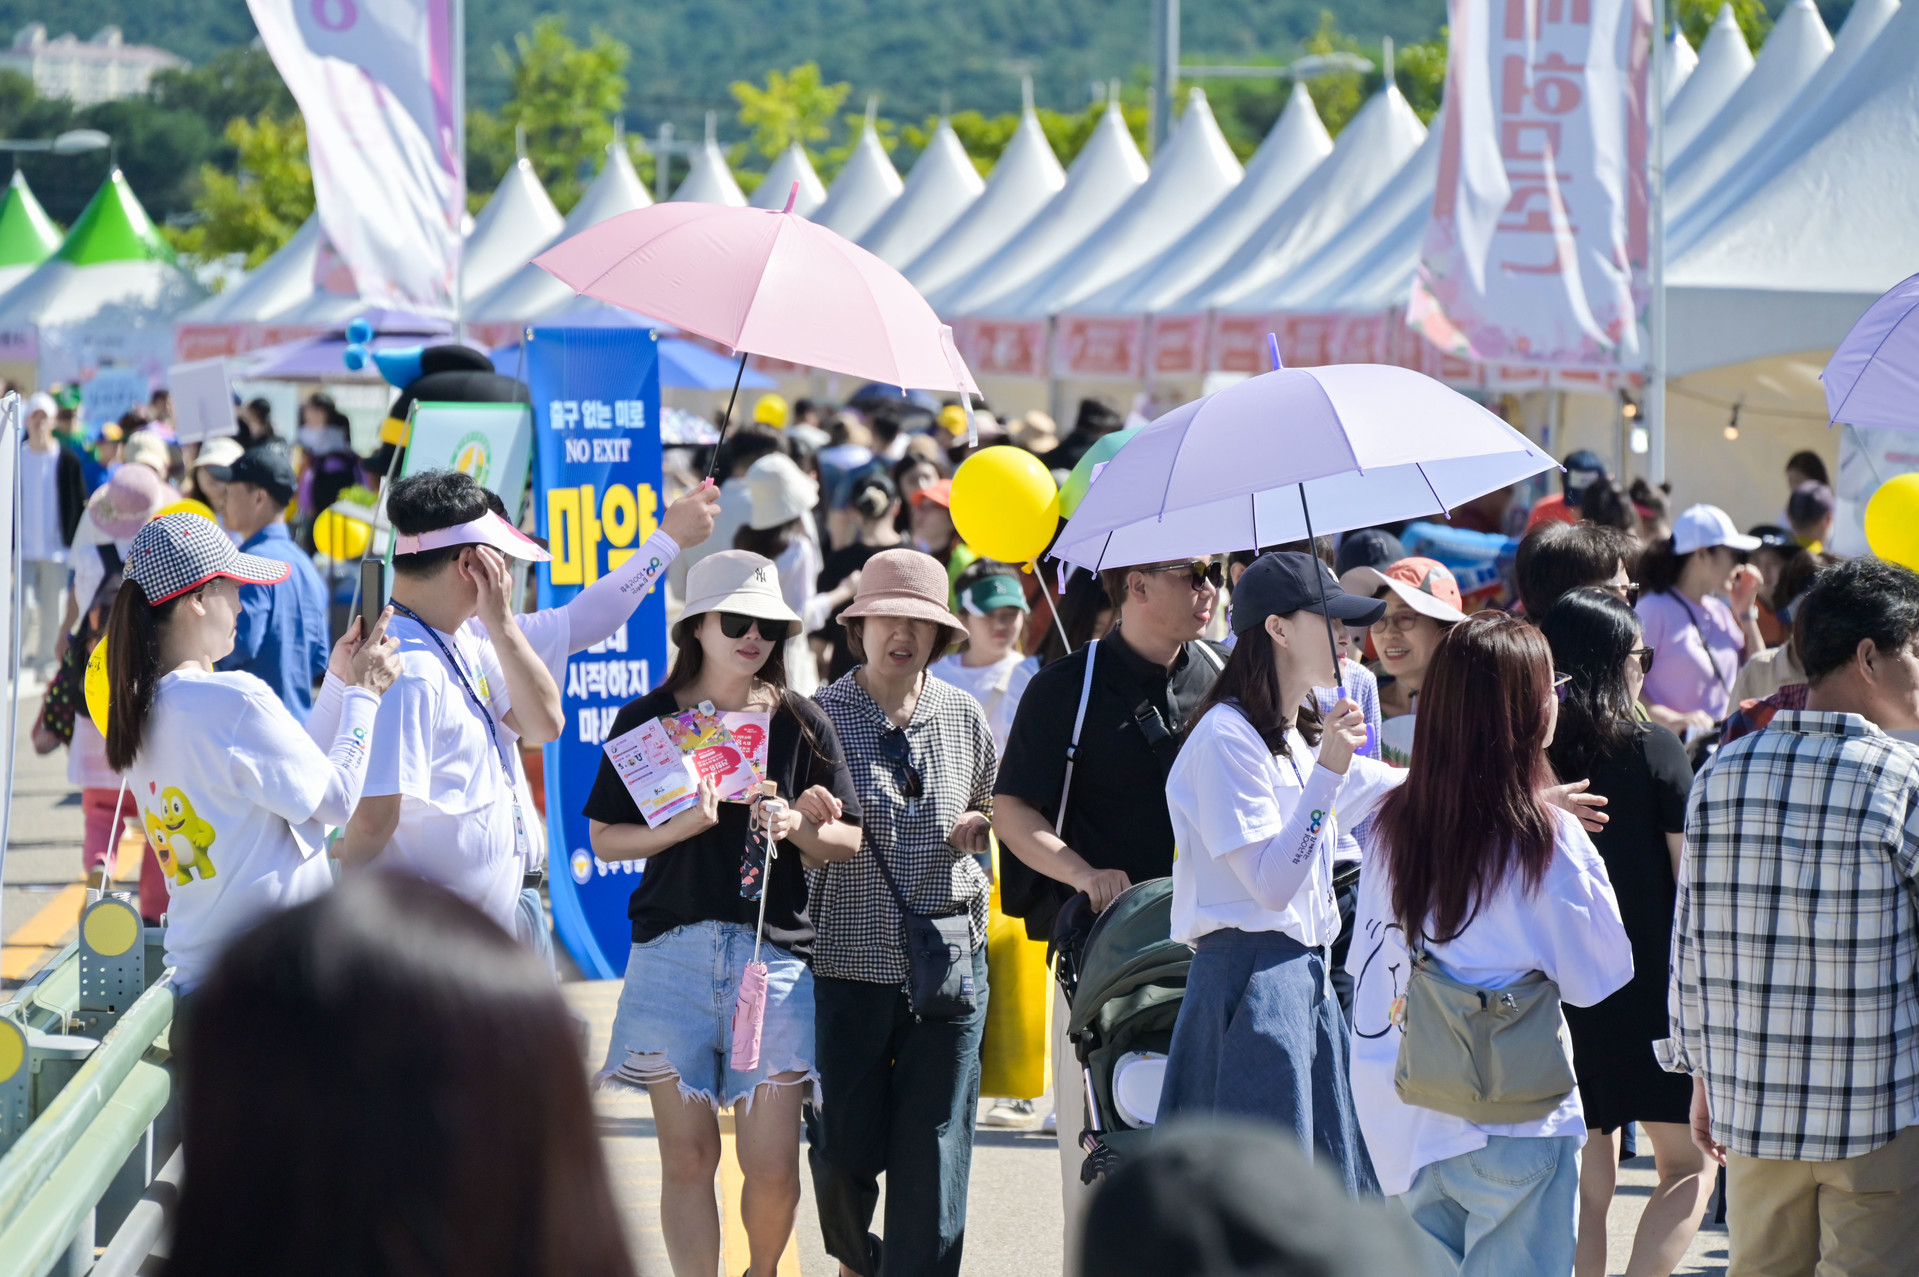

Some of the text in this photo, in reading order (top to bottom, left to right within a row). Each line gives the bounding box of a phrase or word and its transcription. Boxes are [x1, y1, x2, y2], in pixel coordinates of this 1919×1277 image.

[549, 400, 645, 429] 출구 없는 미로
[566, 438, 631, 463] NO EXIT
[547, 483, 658, 593] 마약
[567, 659, 650, 700] 시작하지
